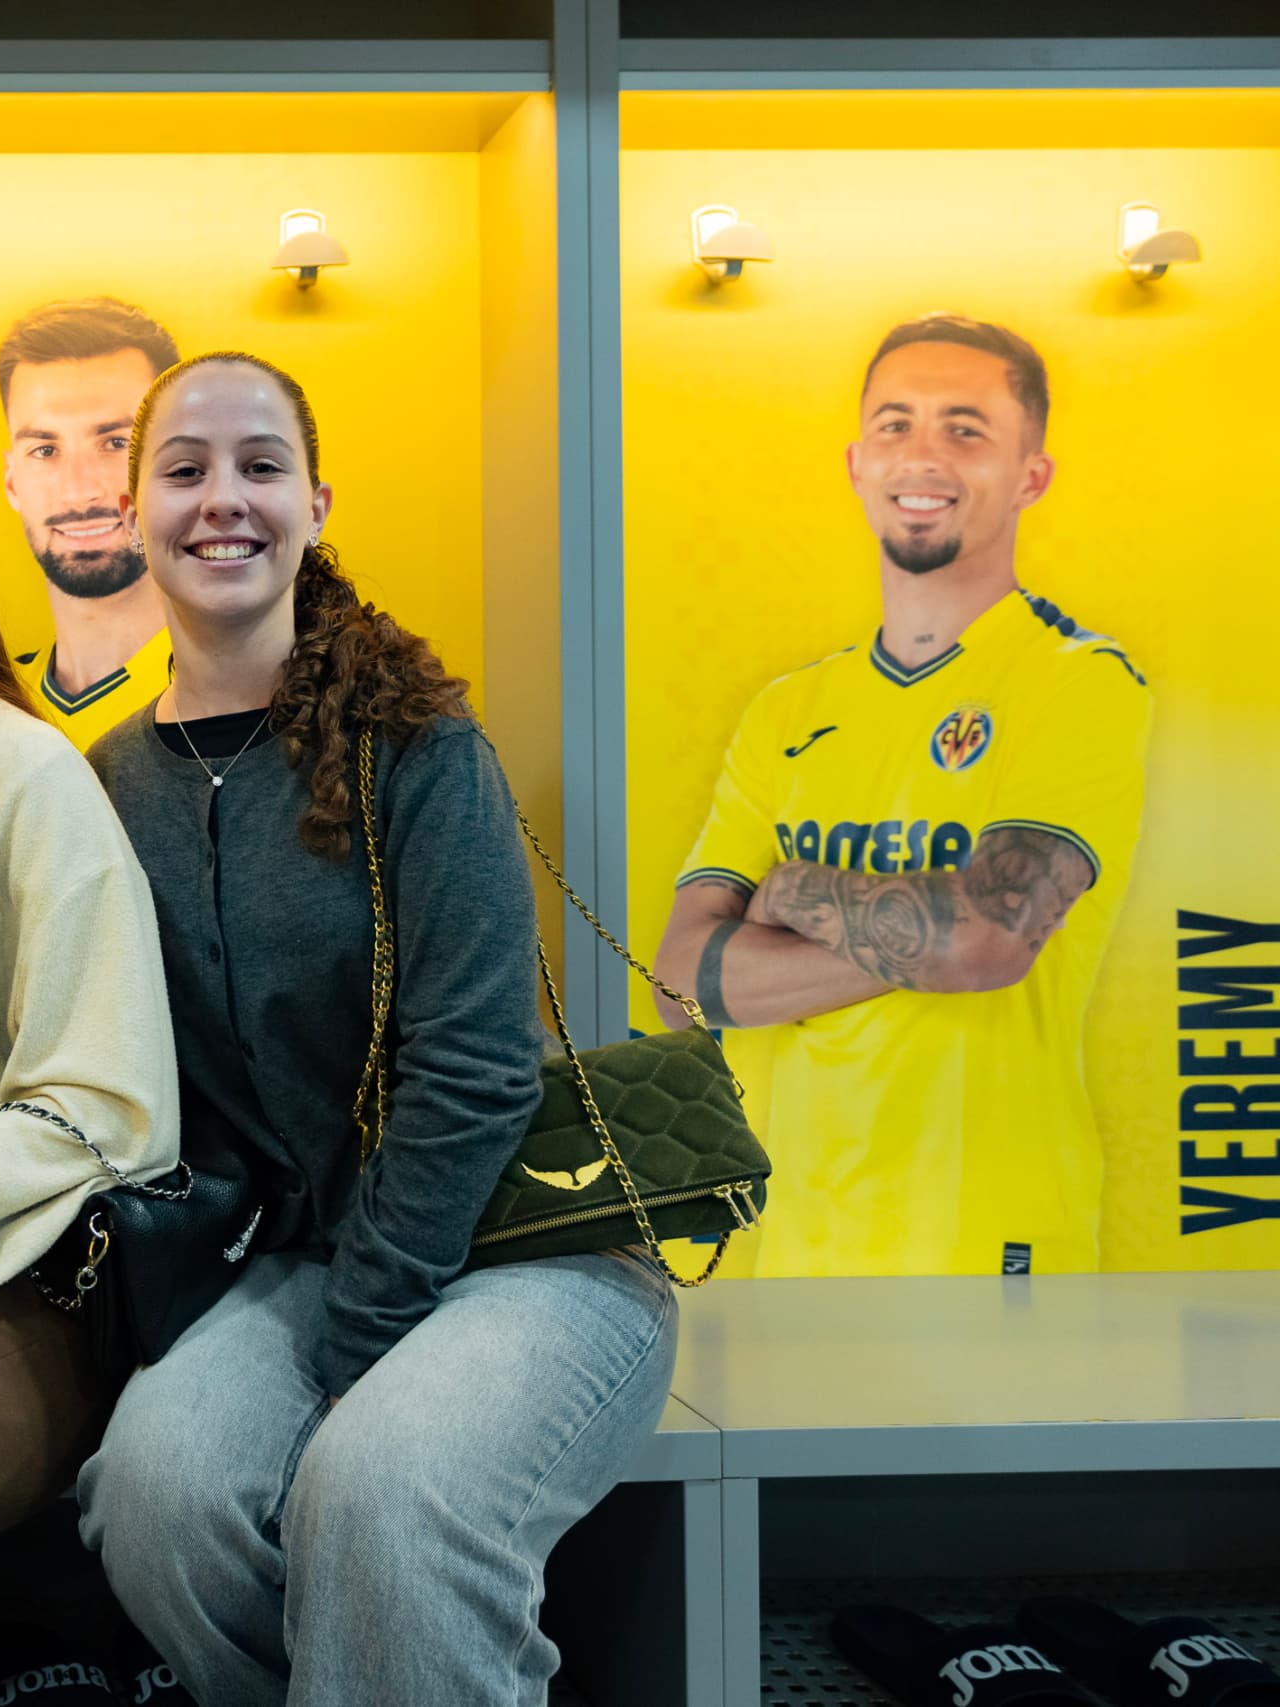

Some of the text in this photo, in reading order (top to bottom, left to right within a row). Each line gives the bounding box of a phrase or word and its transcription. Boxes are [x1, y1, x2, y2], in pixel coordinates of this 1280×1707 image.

[1177, 909, 1280, 1235] YEREMY
[938, 1643, 1062, 1707] Jom
[1149, 1633, 1262, 1698] Jom
